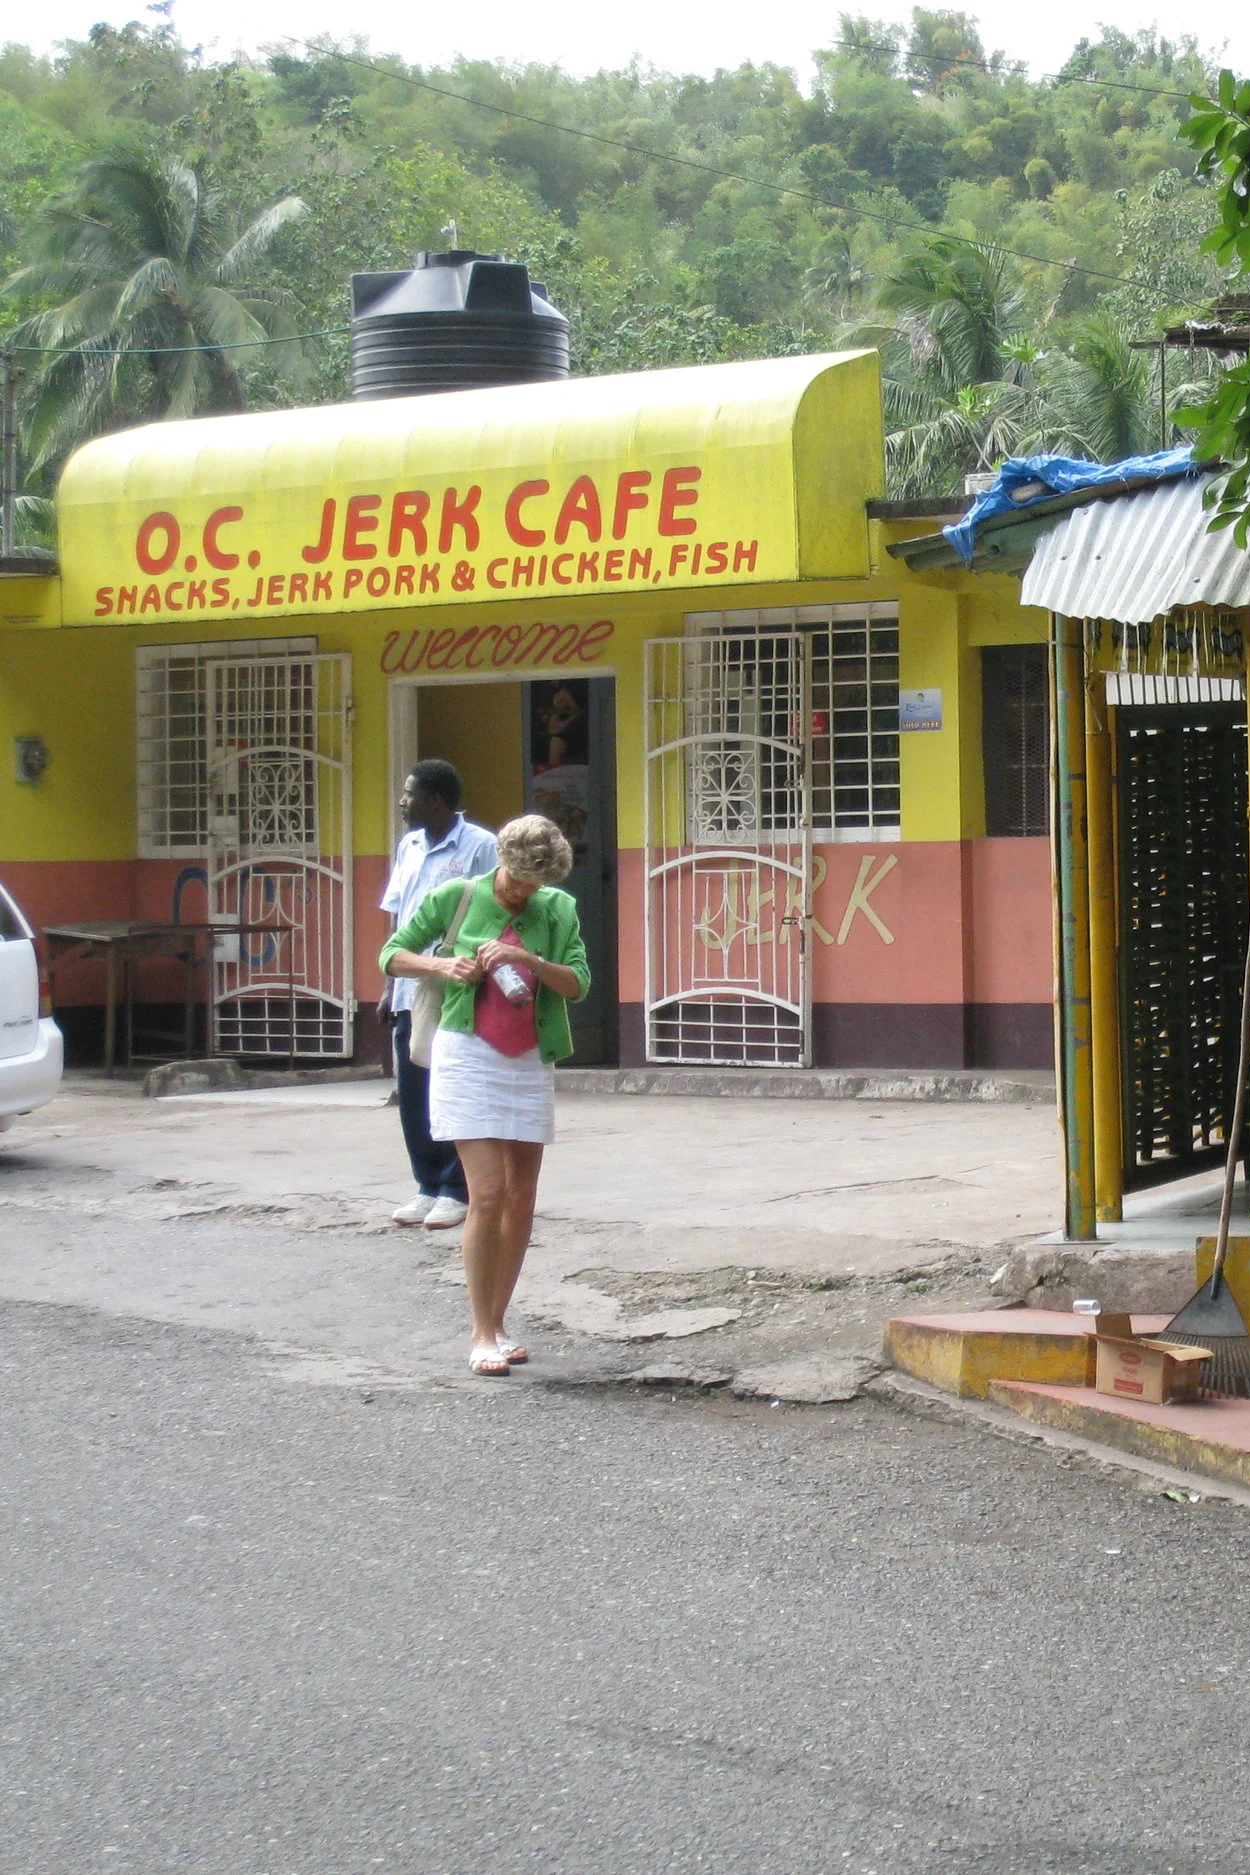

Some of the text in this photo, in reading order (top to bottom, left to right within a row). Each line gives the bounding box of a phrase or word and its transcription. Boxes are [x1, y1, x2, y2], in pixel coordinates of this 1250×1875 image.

[136, 466, 702, 575] O.C. JERK CAFE
[247, 571, 334, 607] JERK
[343, 562, 441, 599] PORK
[450, 560, 475, 592] &
[669, 540, 758, 576] FISH
[699, 854, 898, 950] JERK
